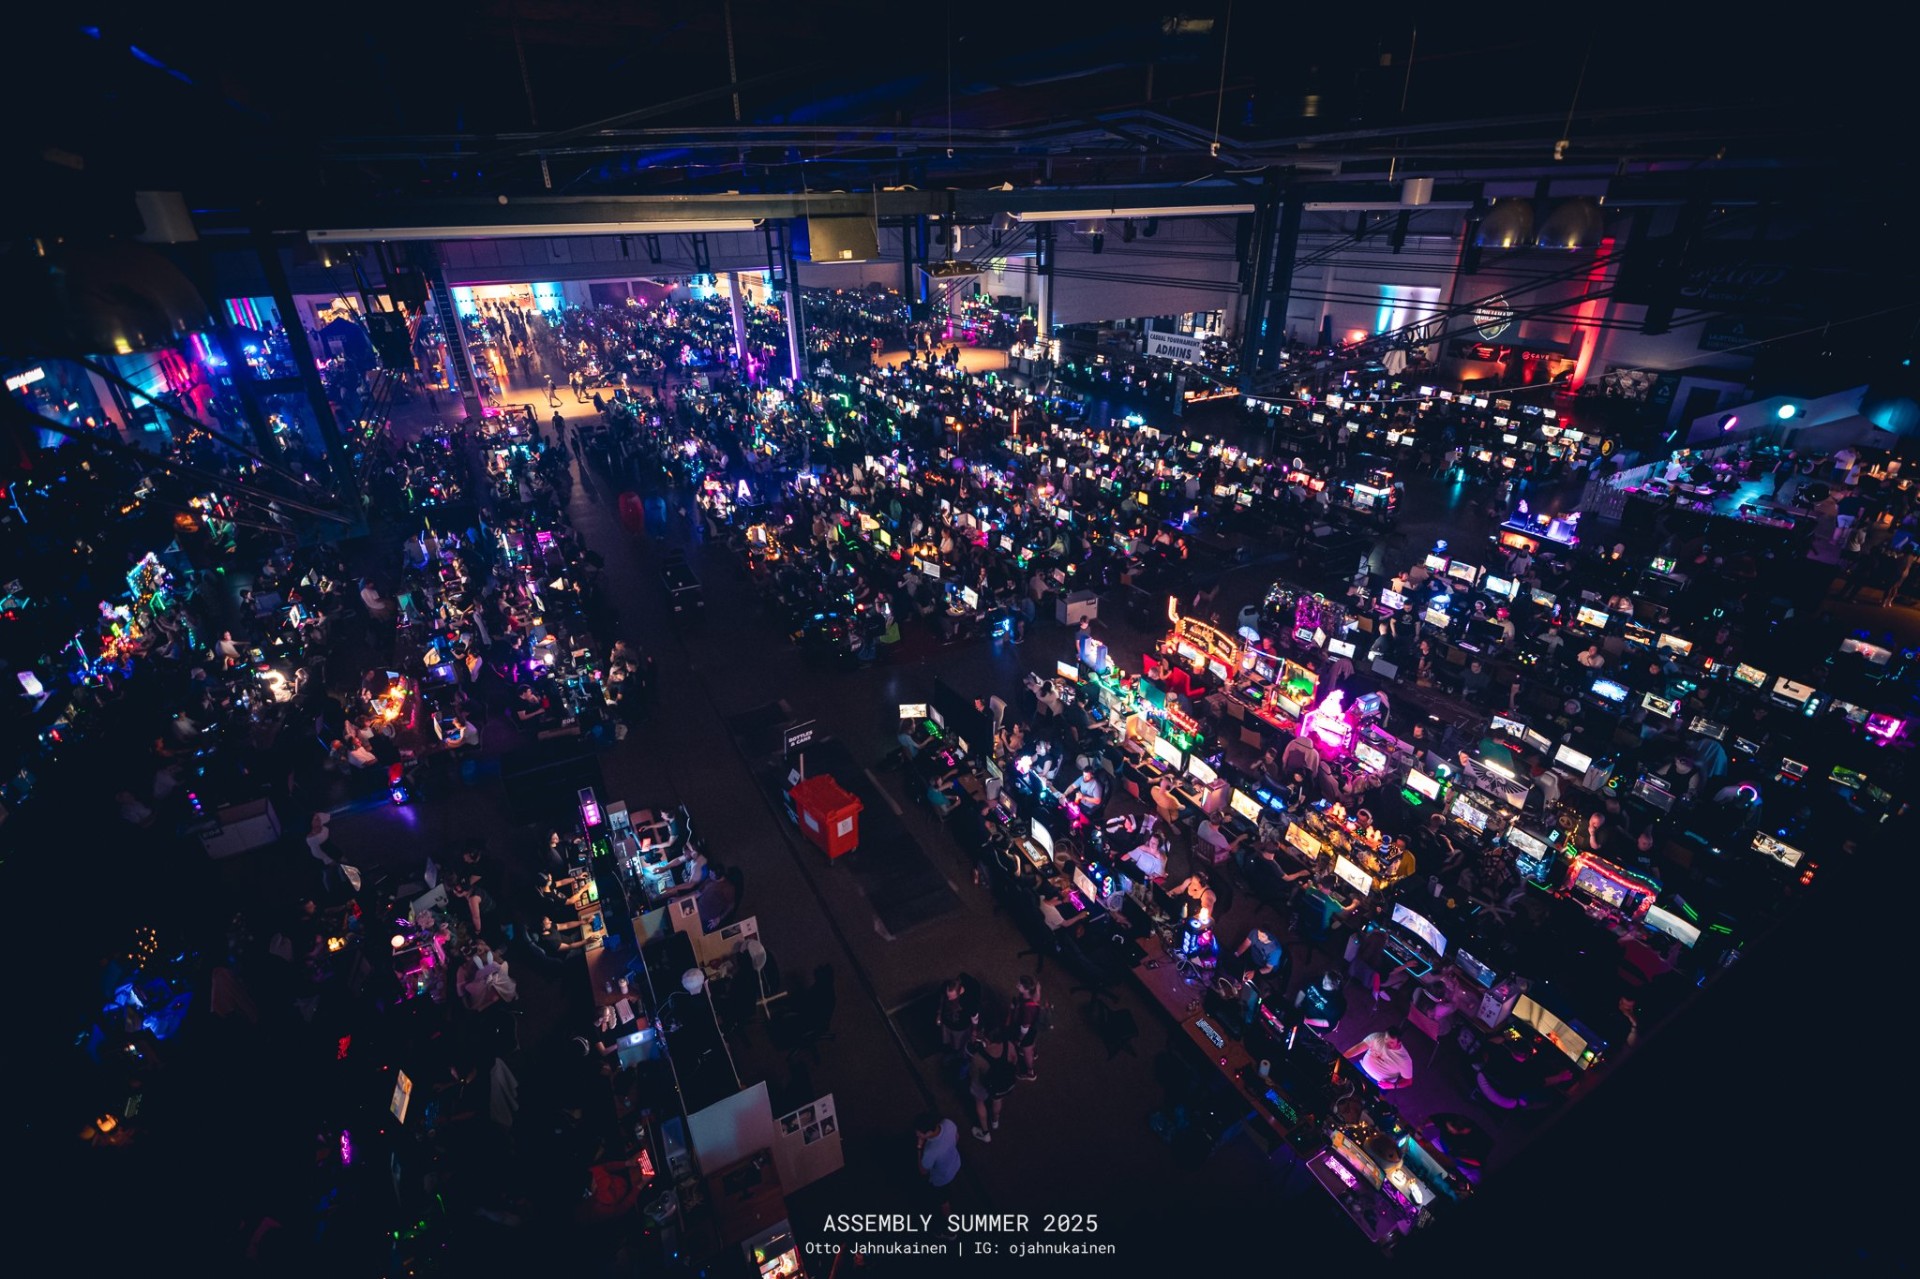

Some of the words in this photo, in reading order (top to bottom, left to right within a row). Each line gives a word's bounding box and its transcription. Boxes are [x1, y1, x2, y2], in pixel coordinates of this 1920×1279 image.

[1149, 333, 1166, 342] CASUAL
[1167, 336, 1200, 348] TOURNAMENT
[1155, 343, 1192, 360] ADMINS
[788, 730, 813, 743] BOTTLES
[796, 735, 812, 745] CANS
